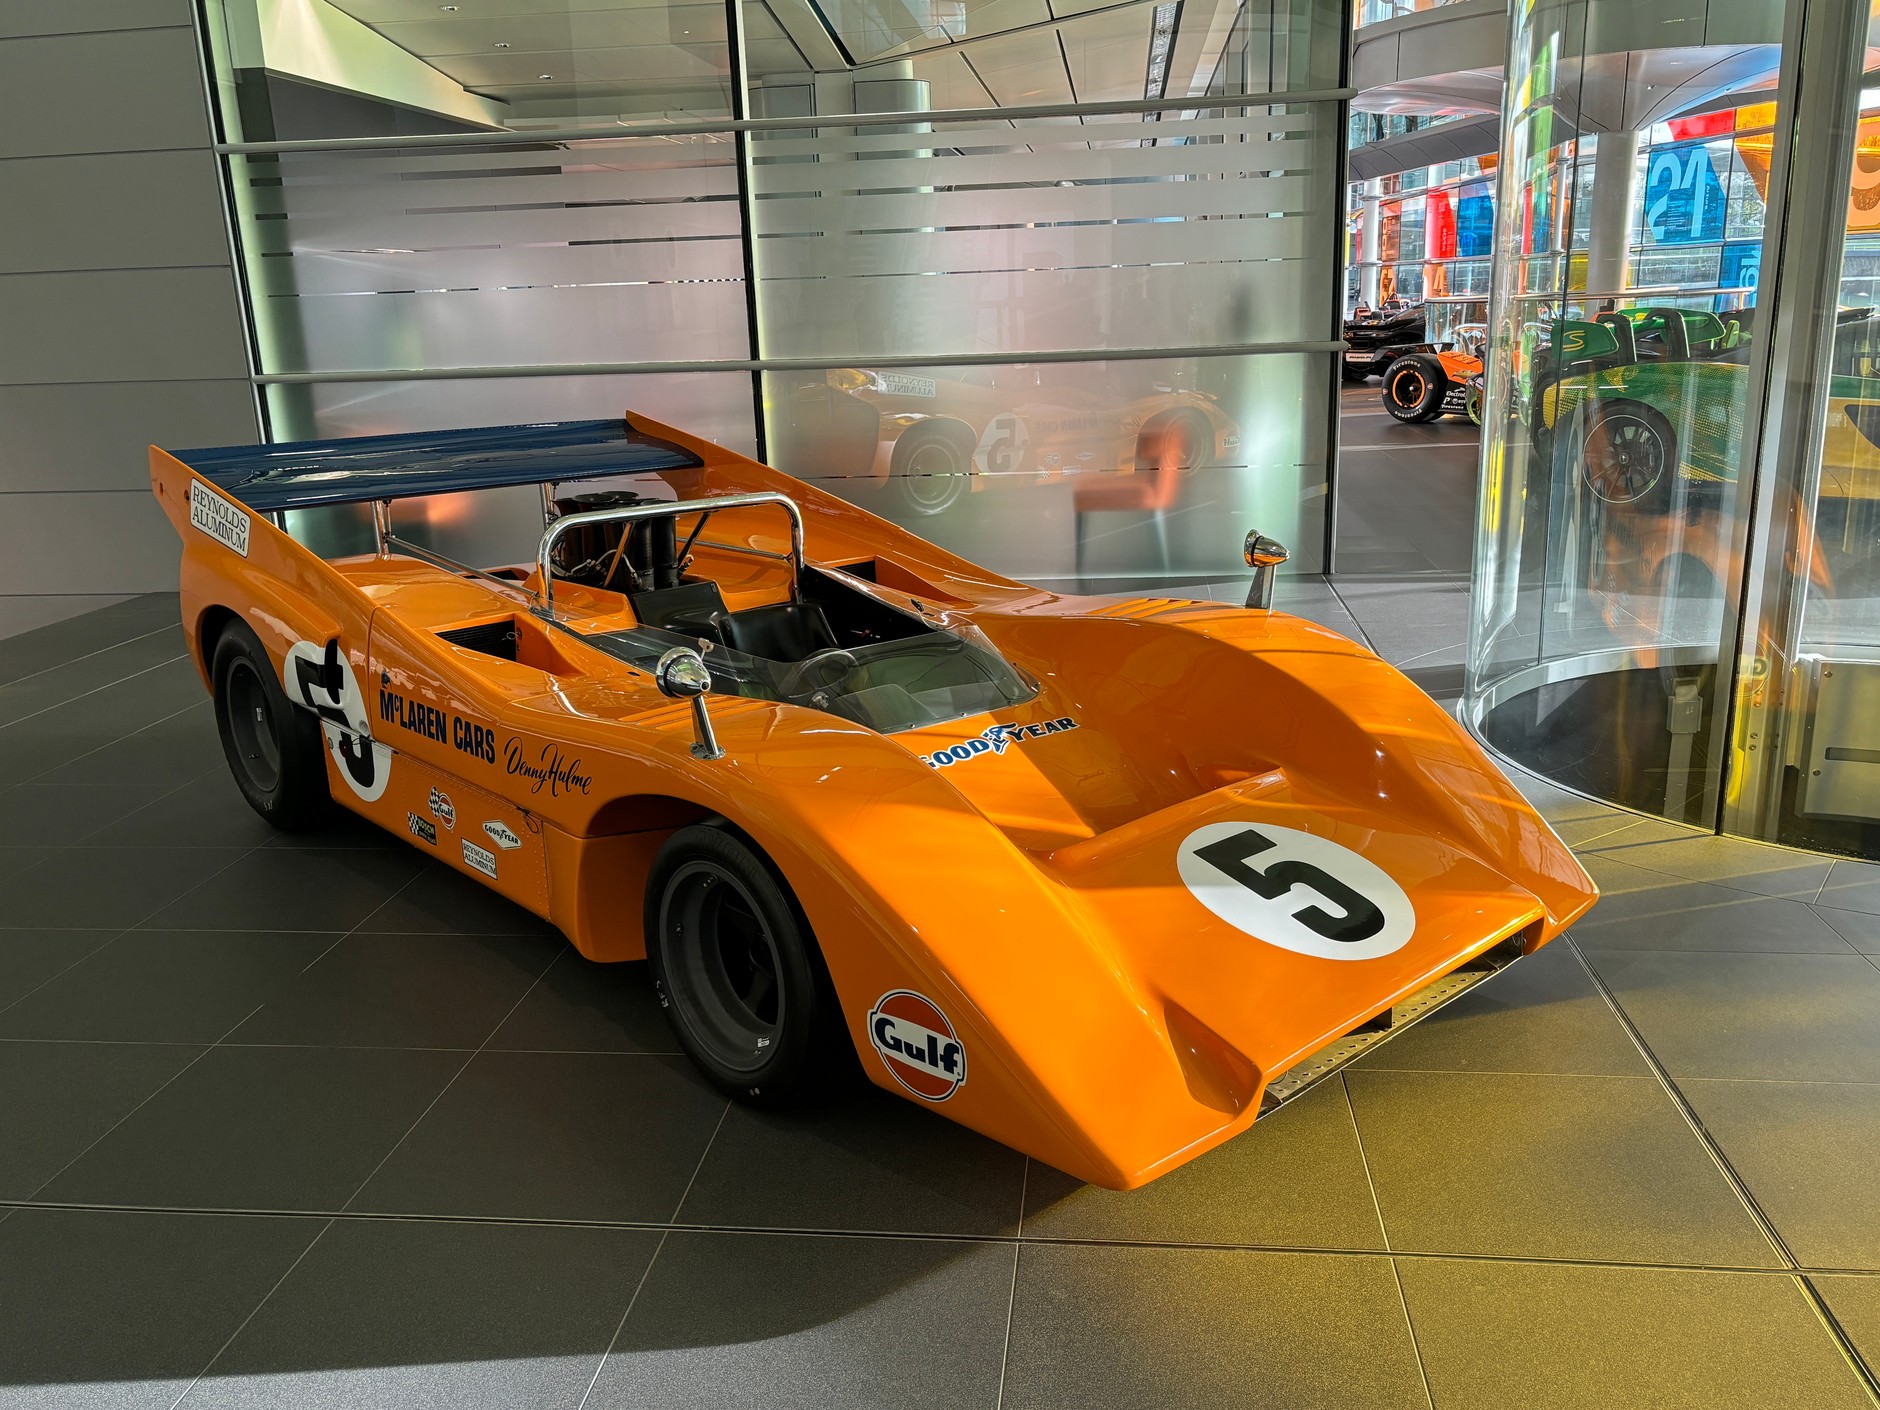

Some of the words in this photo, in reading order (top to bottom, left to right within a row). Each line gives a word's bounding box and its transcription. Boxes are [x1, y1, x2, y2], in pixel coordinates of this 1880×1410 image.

[1393, 360, 1421, 371] Firestone
[1394, 408, 1422, 418] Firestone
[192, 506, 246, 552] ALUMINUM
[193, 485, 247, 534] REYNOLDS
[294, 653, 375, 788] 5
[453, 716, 496, 764] CARS
[503, 736, 548, 794] Denny
[540, 743, 593, 797] Hulme
[439, 804, 454, 818] Gulf
[463, 843, 495, 866] REYNOLDS
[464, 852, 497, 875] ALUMINUM
[1192, 829, 1386, 943] 5
[874, 1017, 960, 1075] Gulf
